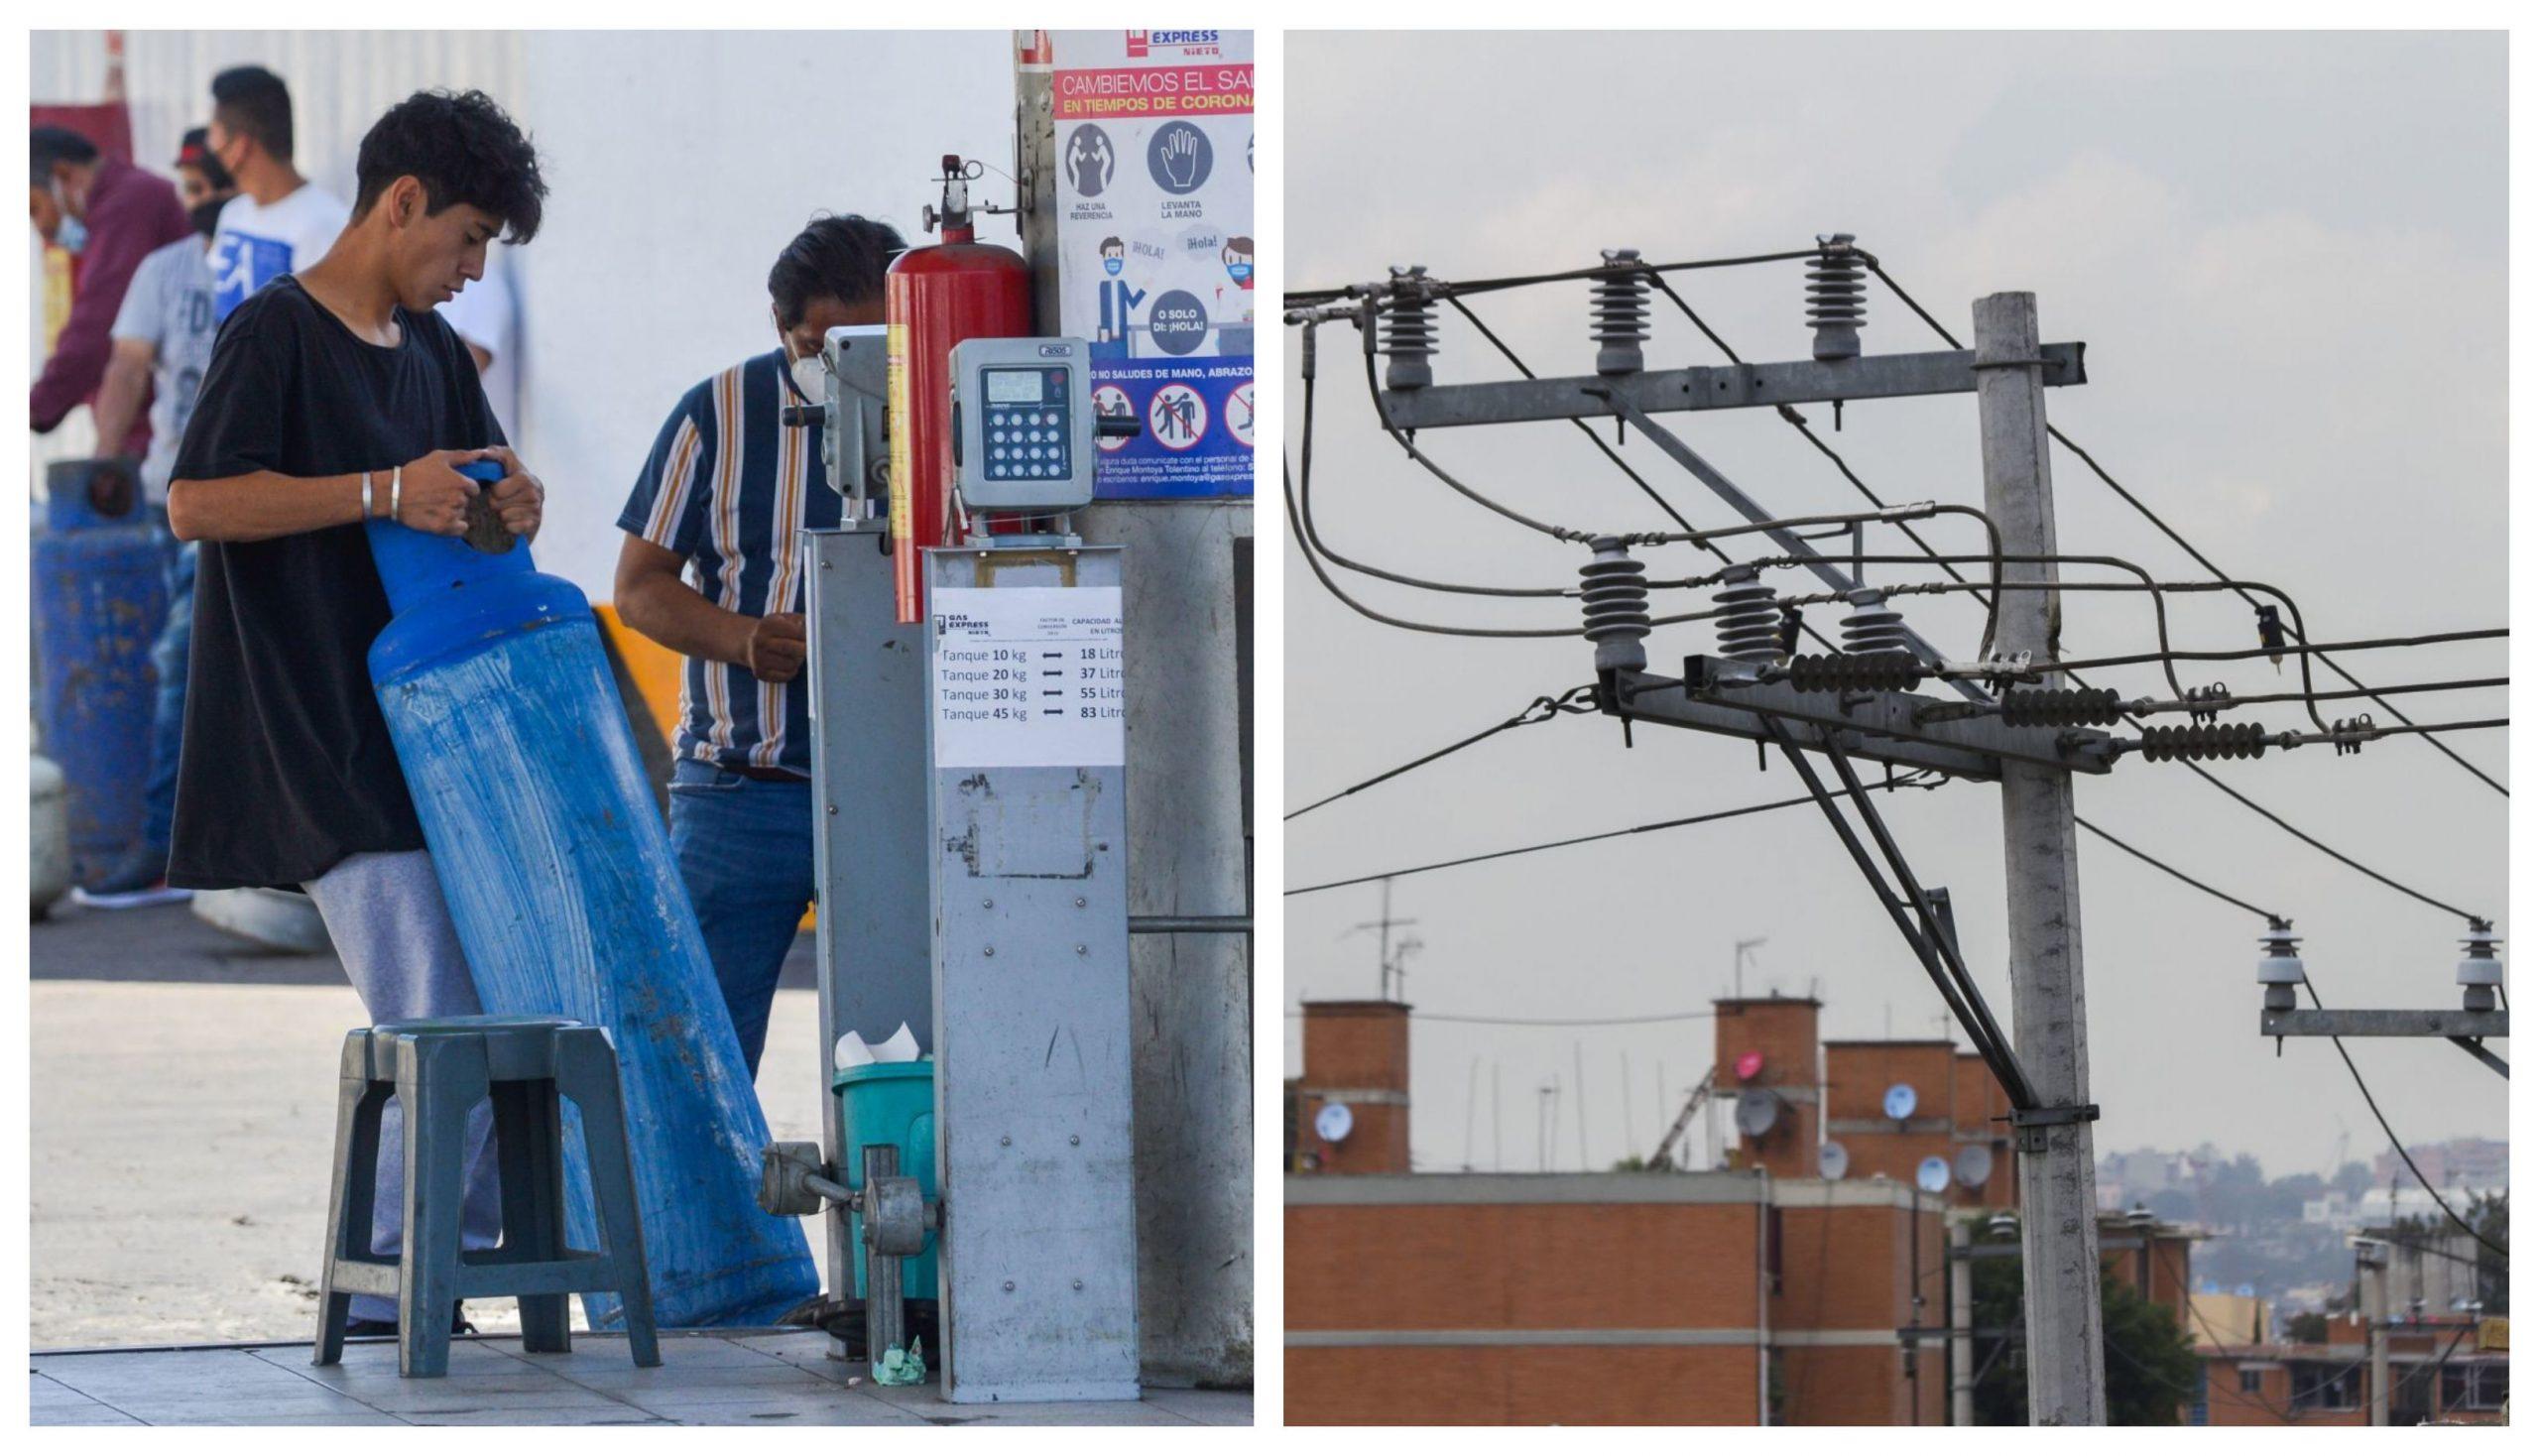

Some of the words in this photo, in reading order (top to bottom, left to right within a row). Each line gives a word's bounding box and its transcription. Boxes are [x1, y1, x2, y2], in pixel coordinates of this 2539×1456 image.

[1152, 30, 1219, 44] EXPRESS
[1062, 72, 1179, 95] CAMBIEMOS
[1184, 71, 1212, 91] EL
[1063, 100, 1082, 113] EN
[1085, 97, 1148, 112] TIEMPOS
[1153, 96, 1176, 110] DE
[1181, 94, 1254, 109] CORON
[1161, 200, 1201, 210] LEVANTA
[1070, 211, 1113, 220] REVERENCIA
[1161, 210, 1172, 219] LA
[1174, 209, 1202, 219] MANO
[1158, 309, 1166, 319] O
[1168, 308, 1197, 319] SOLO
[1098, 370, 1111, 380] NO
[1112, 369, 1153, 380] SALUDES
[1155, 369, 1169, 379] DE
[1171, 368, 1206, 379] MANO,
[1132, 465, 1163, 475] Montoya
[943, 650, 989, 663] Tanque
[993, 650, 1009, 661] 10
[1012, 650, 1027, 664] kg
[1080, 649, 1096, 660] 18
[941, 669, 989, 682] Tanque
[993, 669, 1009, 680] 20
[1012, 669, 1027, 682] kg
[1080, 668, 1096, 679] 37
[941, 688, 989, 702] Tanque
[993, 688, 1009, 700] 30
[1012, 688, 1027, 702] kg
[1080, 687, 1096, 699] 55
[941, 708, 989, 722] Tanque
[993, 708, 1009, 720] 45
[1012, 708, 1027, 722] kg
[1080, 707, 1096, 719] 83
